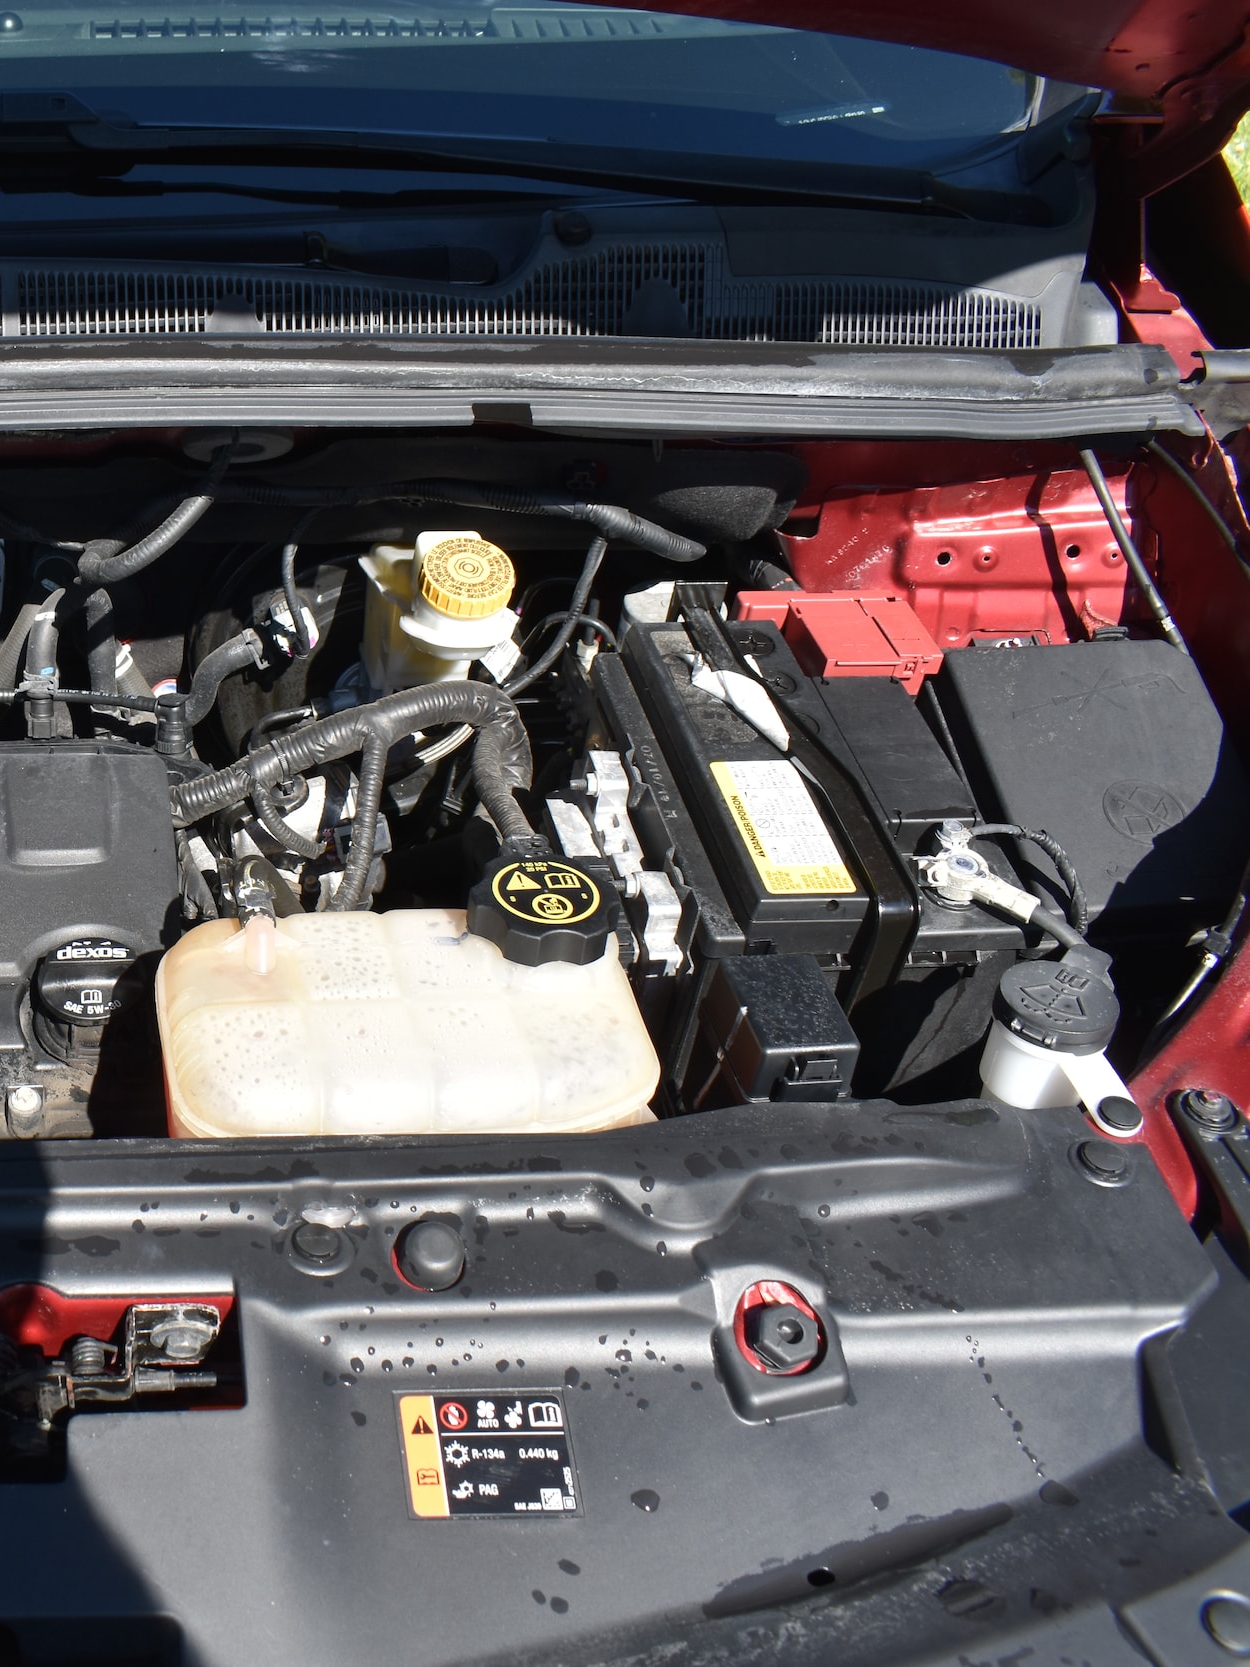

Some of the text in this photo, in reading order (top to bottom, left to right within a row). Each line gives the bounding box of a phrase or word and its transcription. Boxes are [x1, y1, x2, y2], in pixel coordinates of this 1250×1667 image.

[730, 795, 763, 851] DANGER/POISON
[56, 946, 128, 961] dexos
[63, 999, 122, 1015] SAE 5W-30
[477, 1418, 500, 1428] AUTO
[471, 1447, 559, 1461] R-134a 0.440 kg
[478, 1483, 499, 1496] PAG
